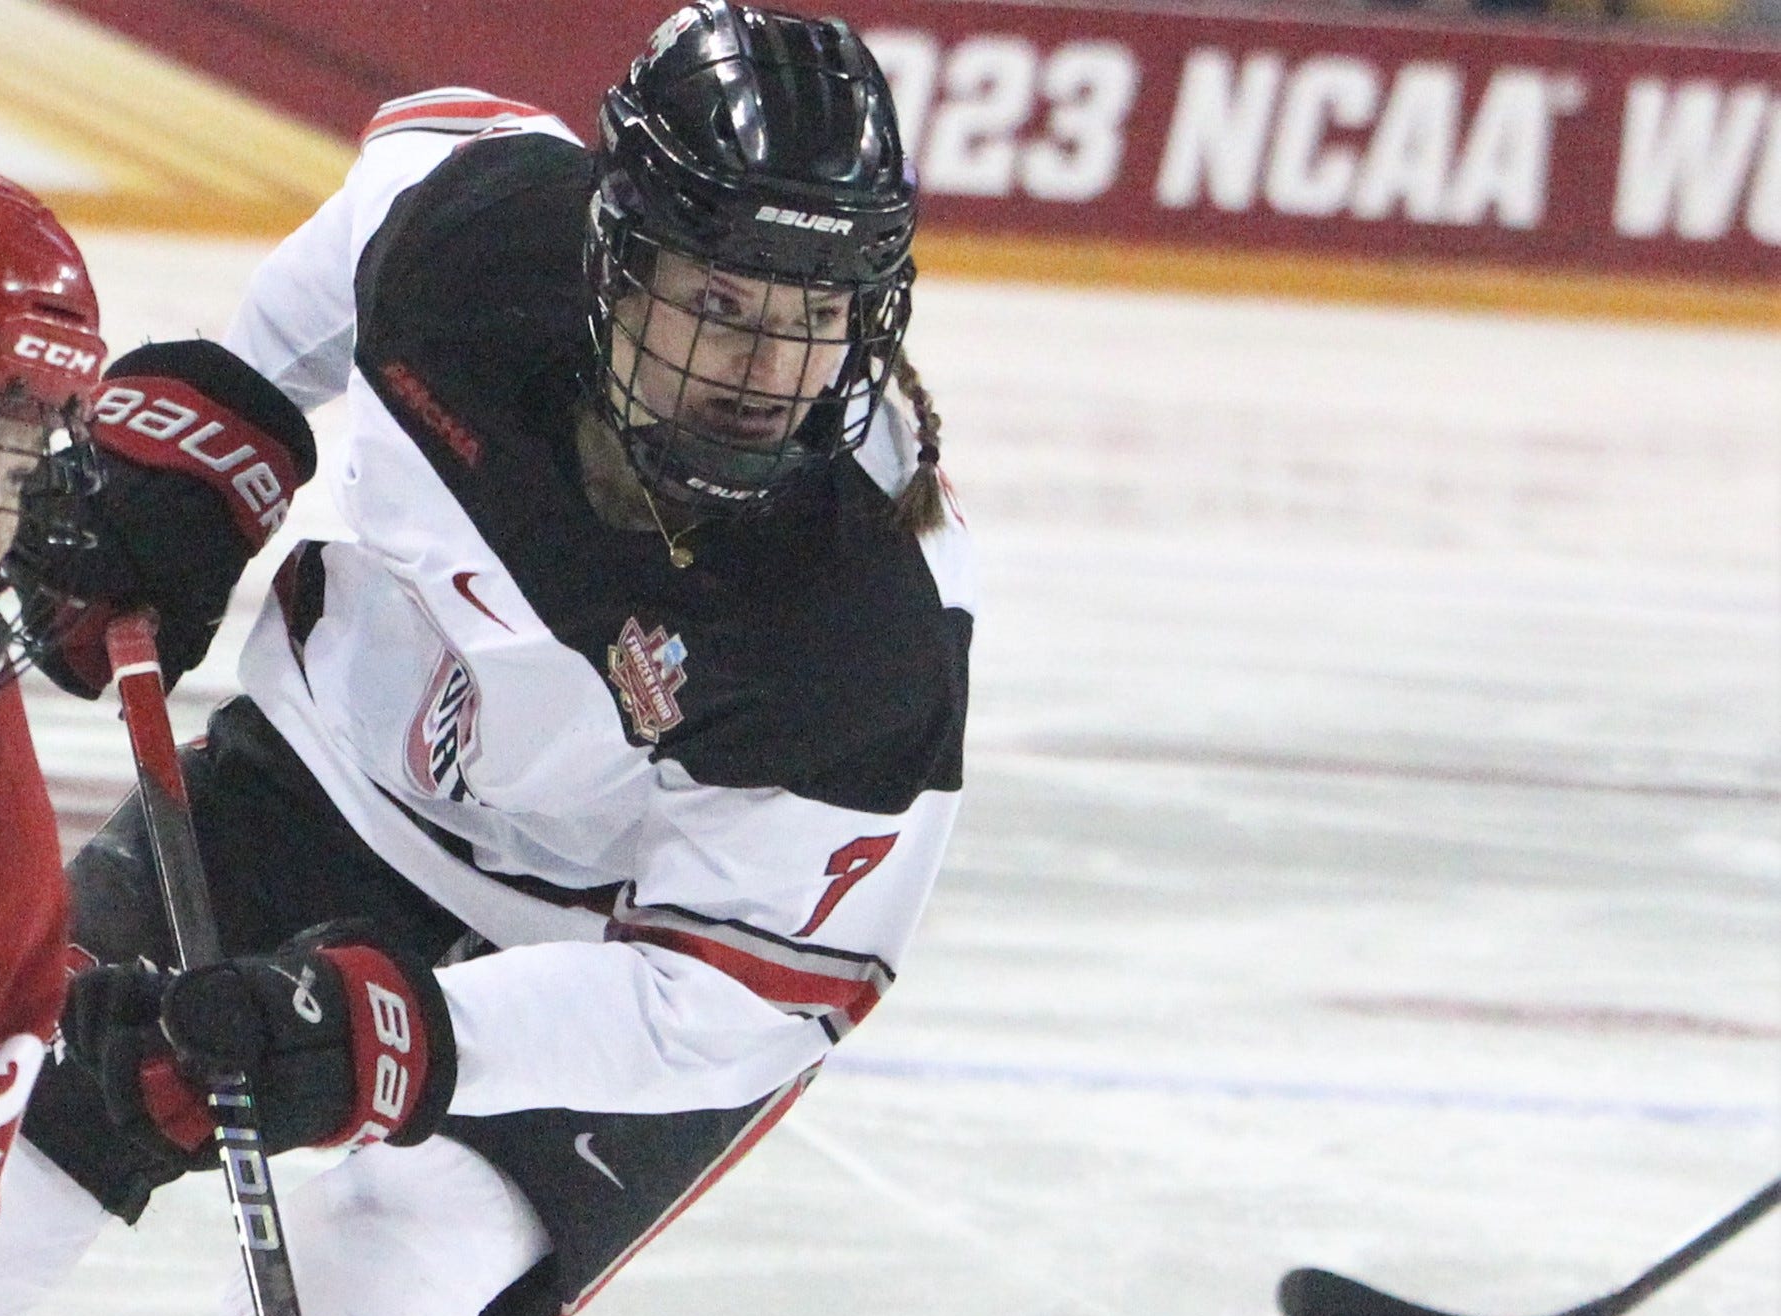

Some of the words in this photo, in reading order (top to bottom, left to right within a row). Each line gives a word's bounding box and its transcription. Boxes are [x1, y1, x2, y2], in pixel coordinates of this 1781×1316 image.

[1154, 46, 1551, 232] NCAA
[755, 206, 854, 236] BAUER
[13, 334, 98, 375] CCM
[790, 830, 901, 938] 7
